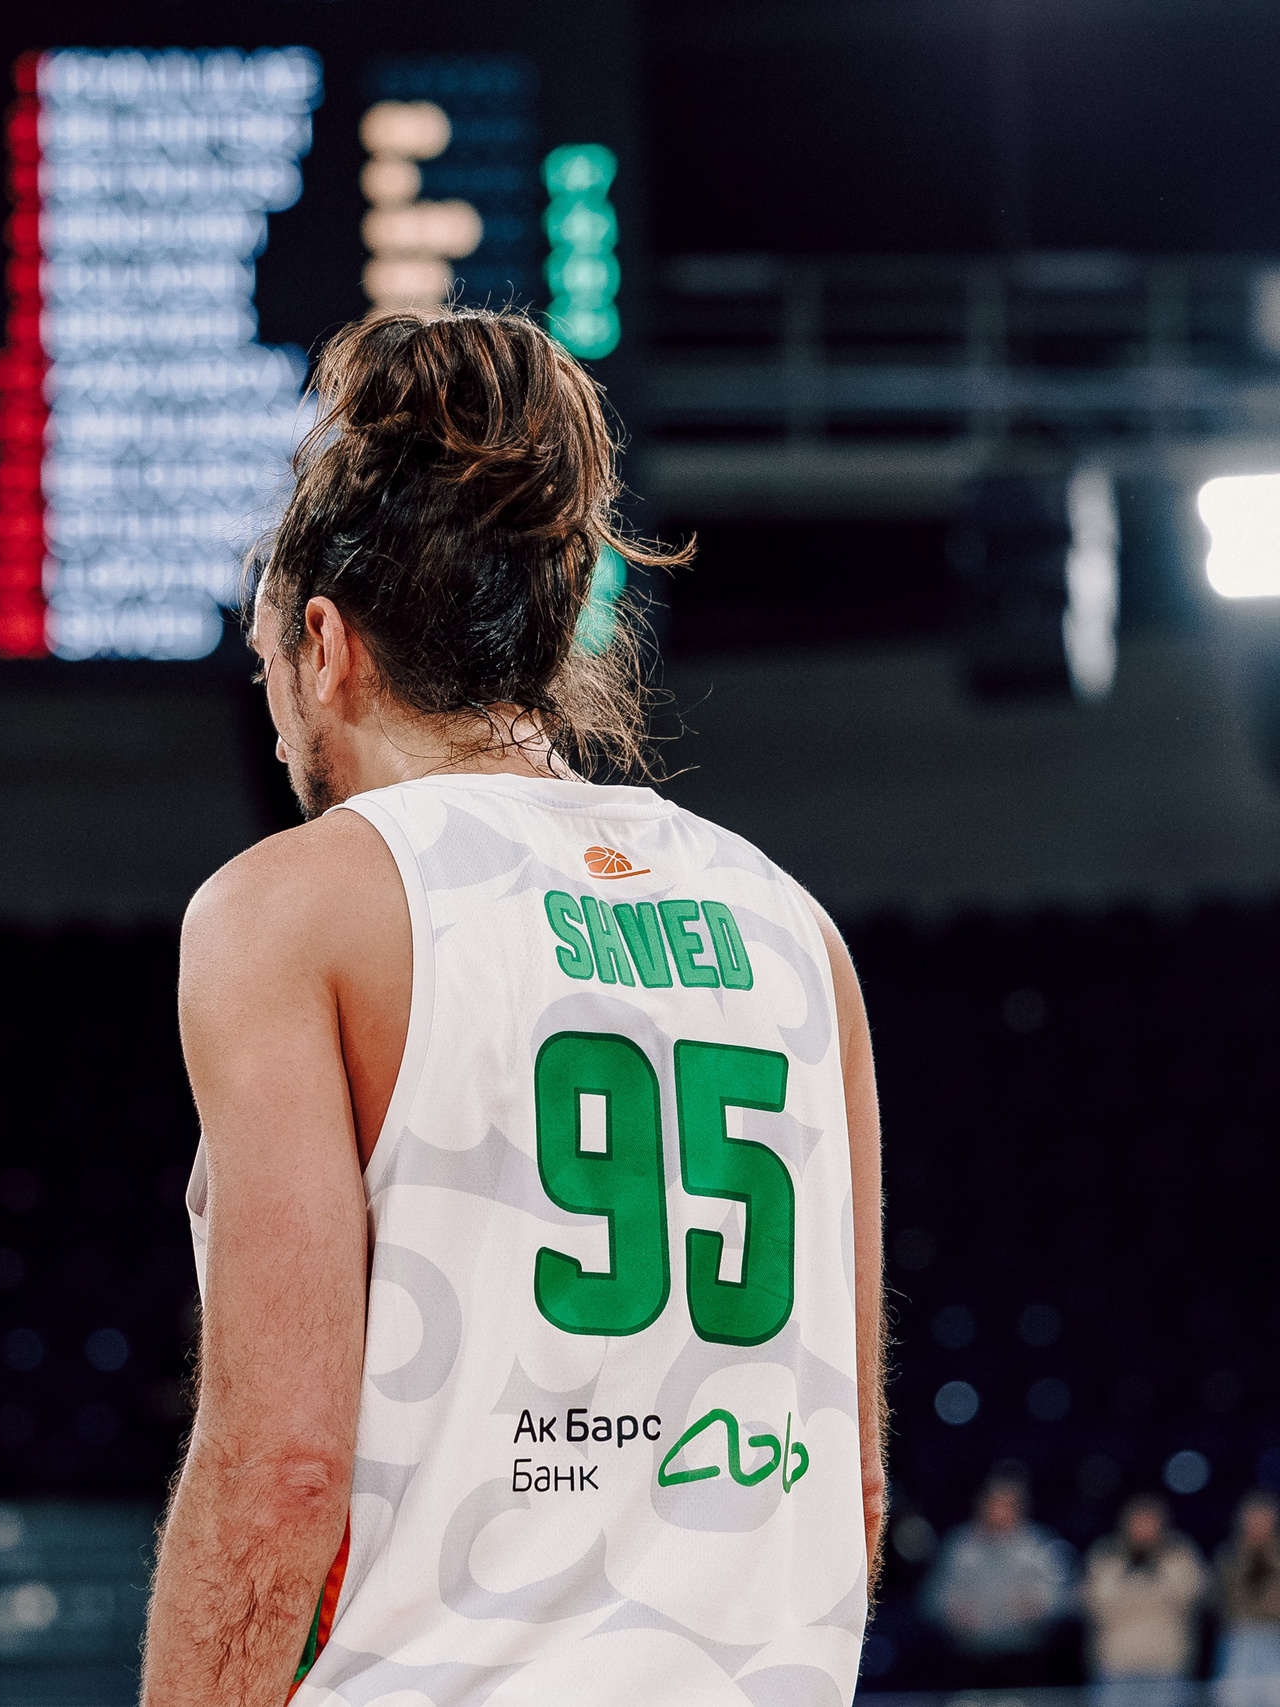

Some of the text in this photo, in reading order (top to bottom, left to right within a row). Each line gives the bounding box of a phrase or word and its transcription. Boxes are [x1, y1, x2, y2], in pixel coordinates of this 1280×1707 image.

[543, 889, 754, 992] SHVED
[533, 1030, 795, 1346] 95
[513, 1407, 662, 1448] Ак Барс
[512, 1457, 599, 1493] Банк
